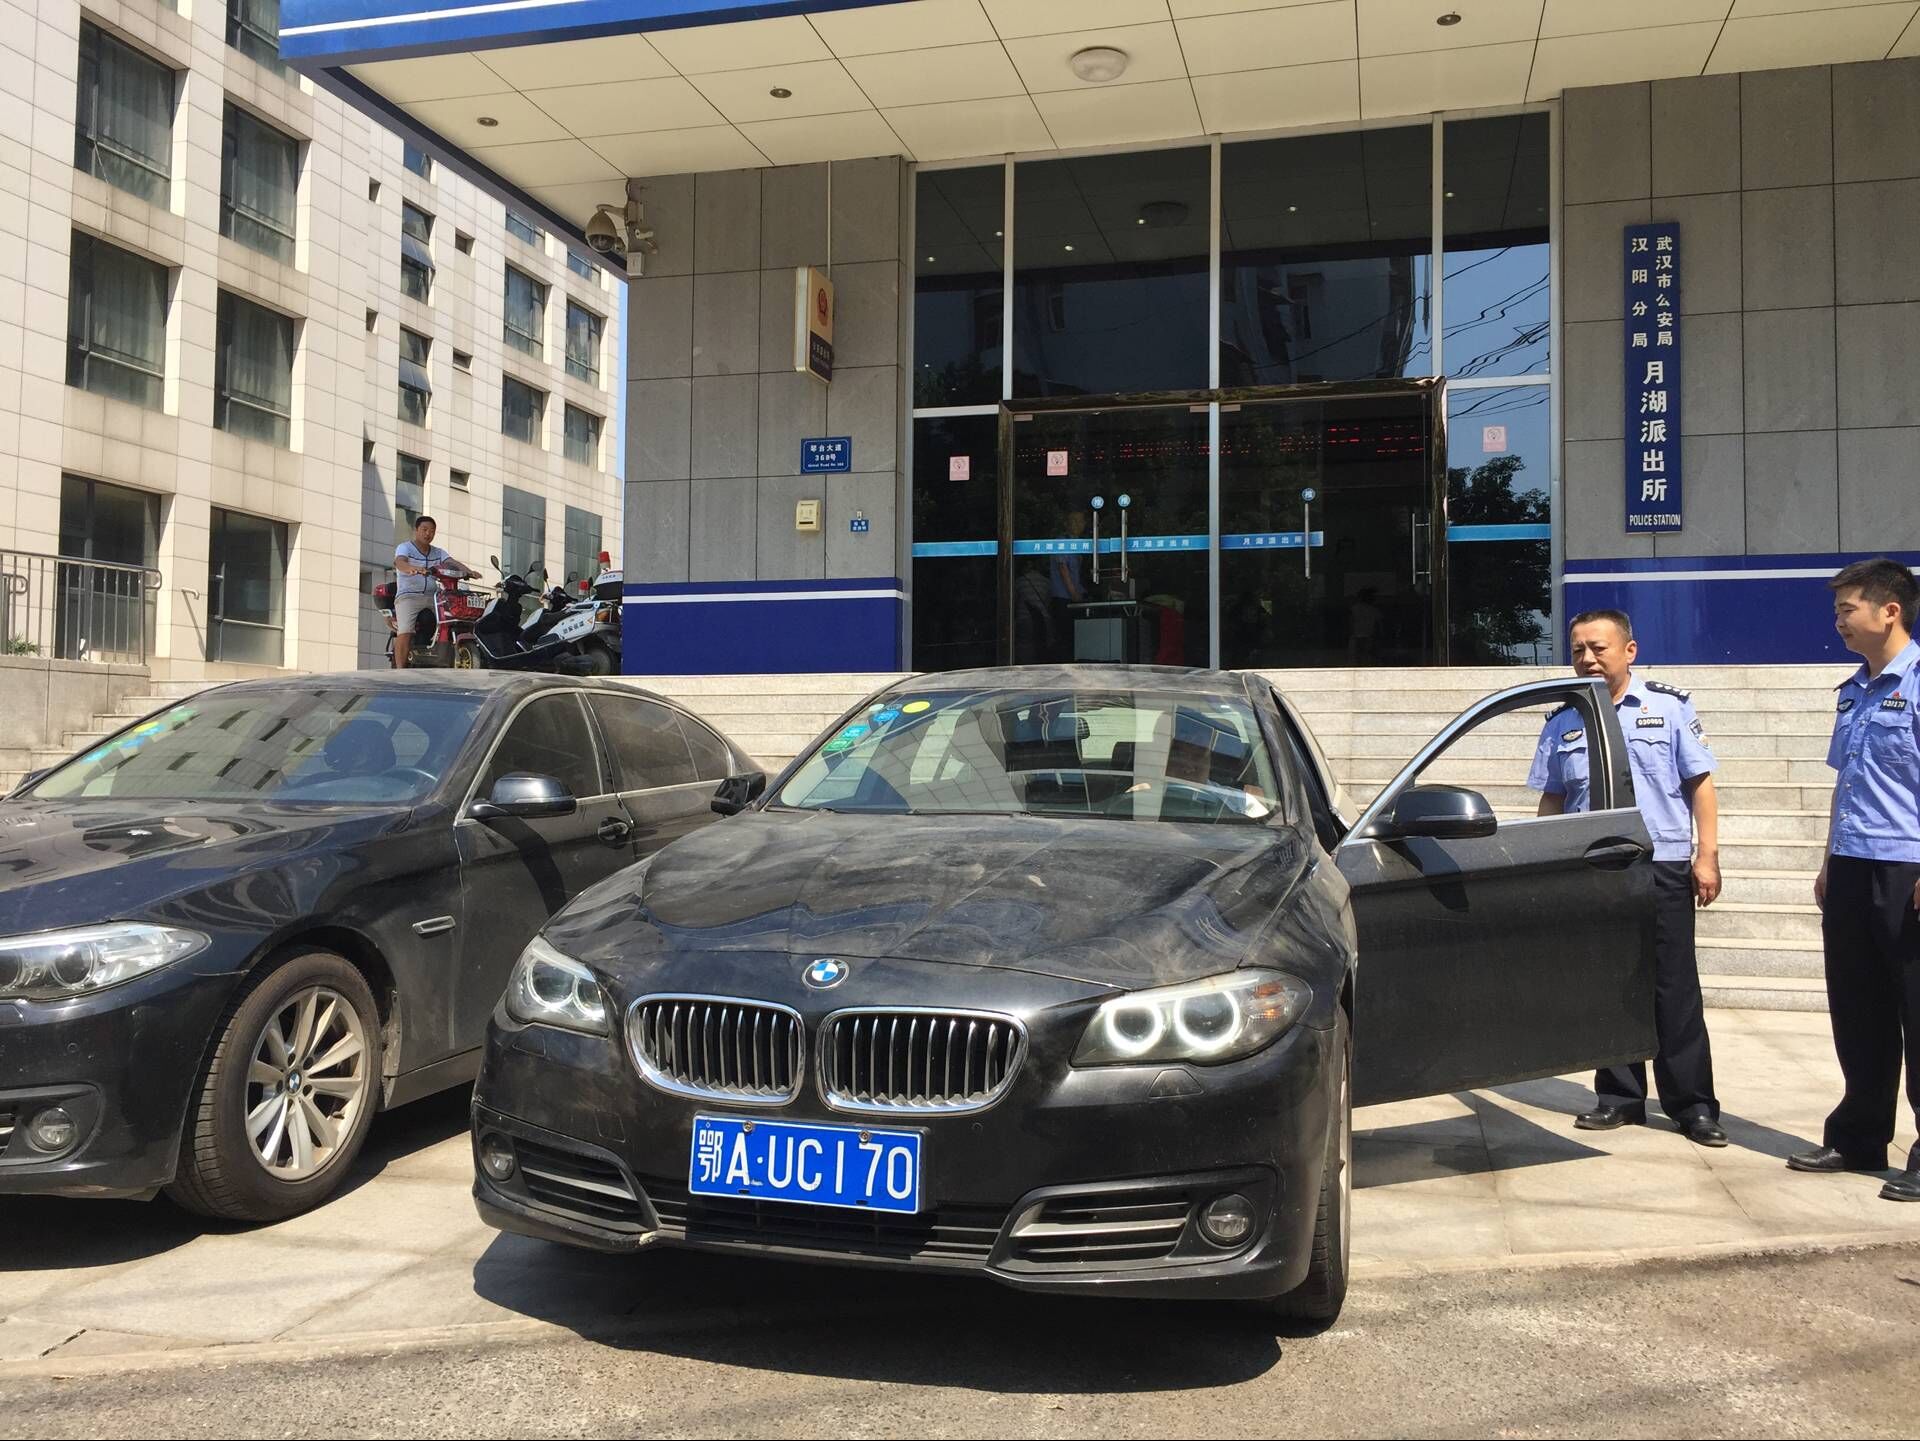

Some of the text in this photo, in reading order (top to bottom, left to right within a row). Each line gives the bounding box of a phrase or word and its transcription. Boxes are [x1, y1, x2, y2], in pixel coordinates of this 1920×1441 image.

[1631, 237, 1649, 348] 汉阳分局
[1655, 235, 1673, 347] 武汉市公安局
[1639, 360, 1668, 502] 月湖派出所
[1629, 514, 1681, 526] POLICE STATION
[1131, 539, 1192, 548] 月湖派出所
[1243, 535, 1303, 545] 月湖派出所
[1033, 542, 1090, 551] 月湖派出所
